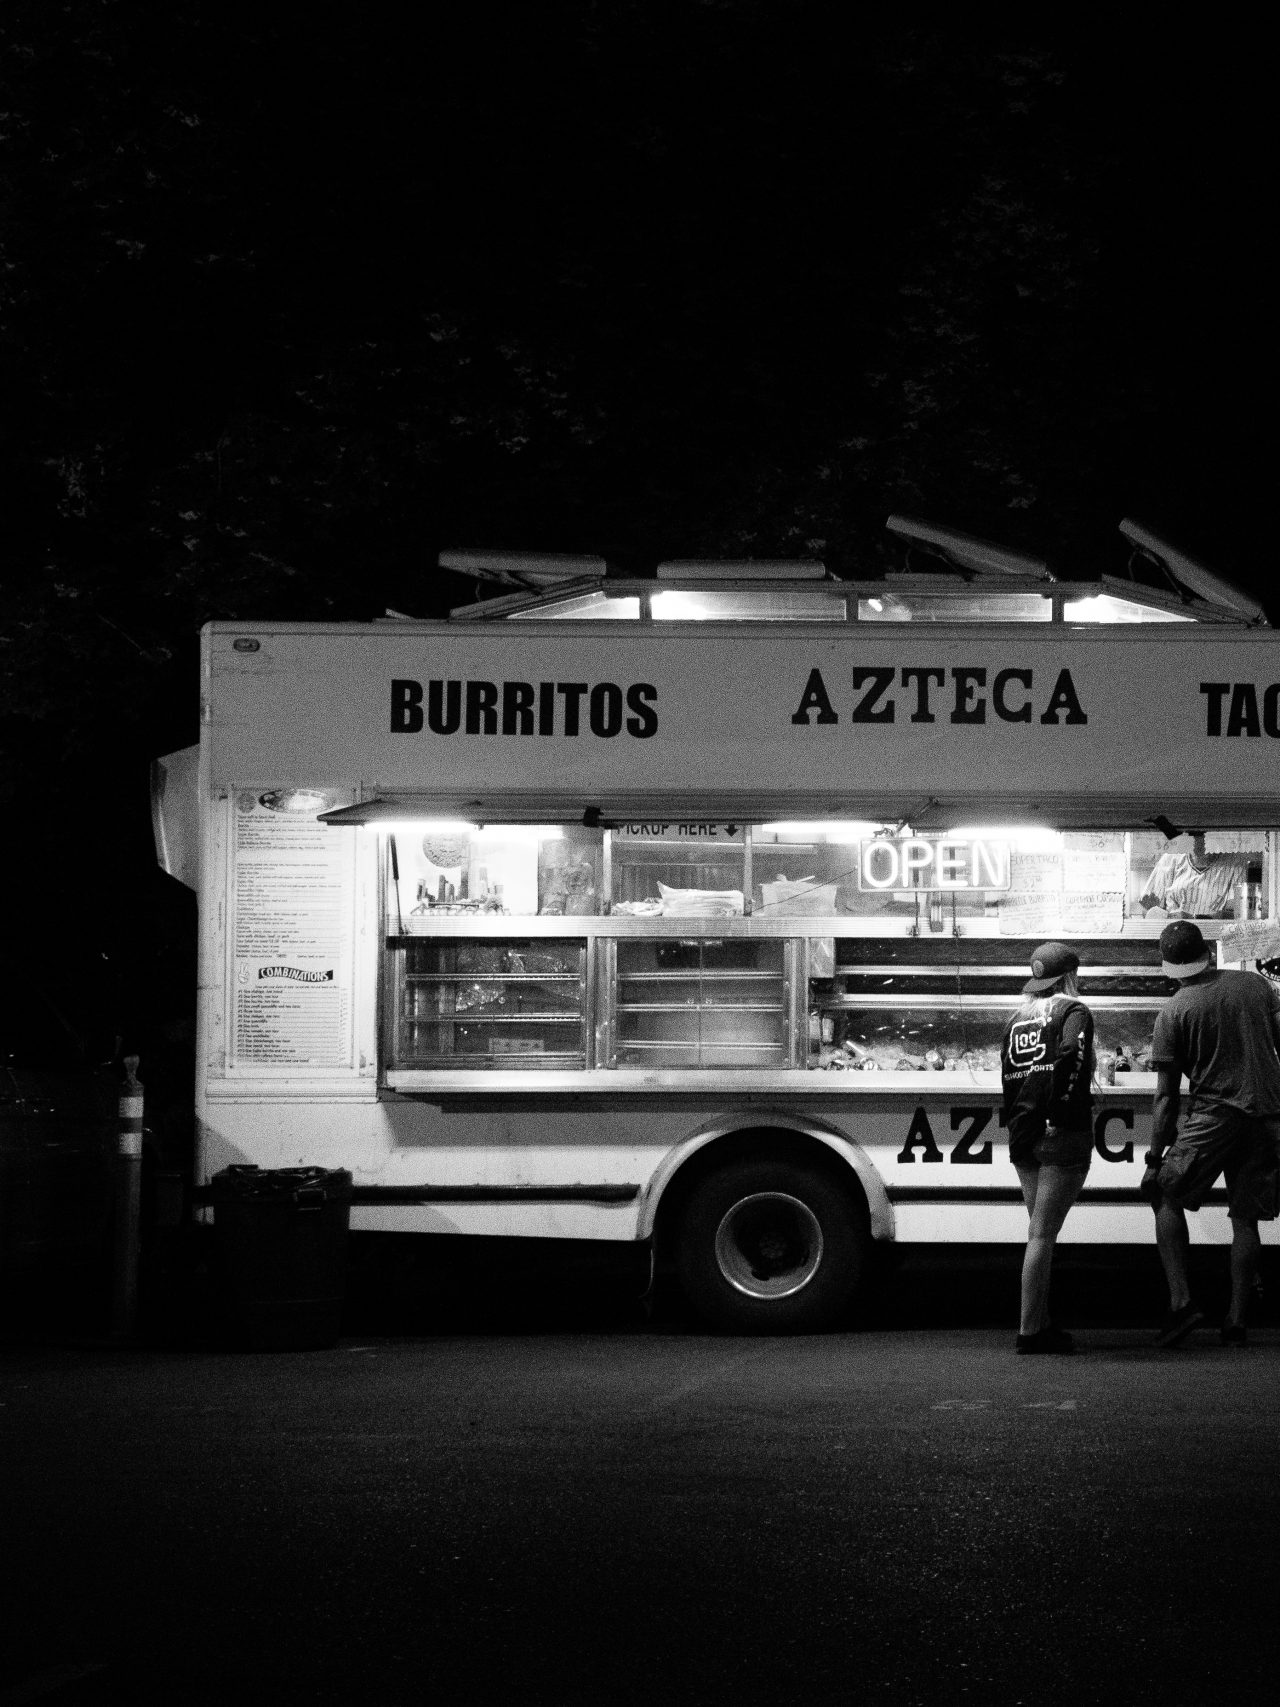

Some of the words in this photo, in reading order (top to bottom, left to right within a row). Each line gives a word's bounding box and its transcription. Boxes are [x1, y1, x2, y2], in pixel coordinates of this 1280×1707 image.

[391, 679, 658, 739] BURRITOS
[791, 667, 1088, 725] AZTECA
[678, 824, 717, 836] HERE
[863, 840, 1004, 888] OPEN
[260, 967, 330, 982] COMBINATIONS
